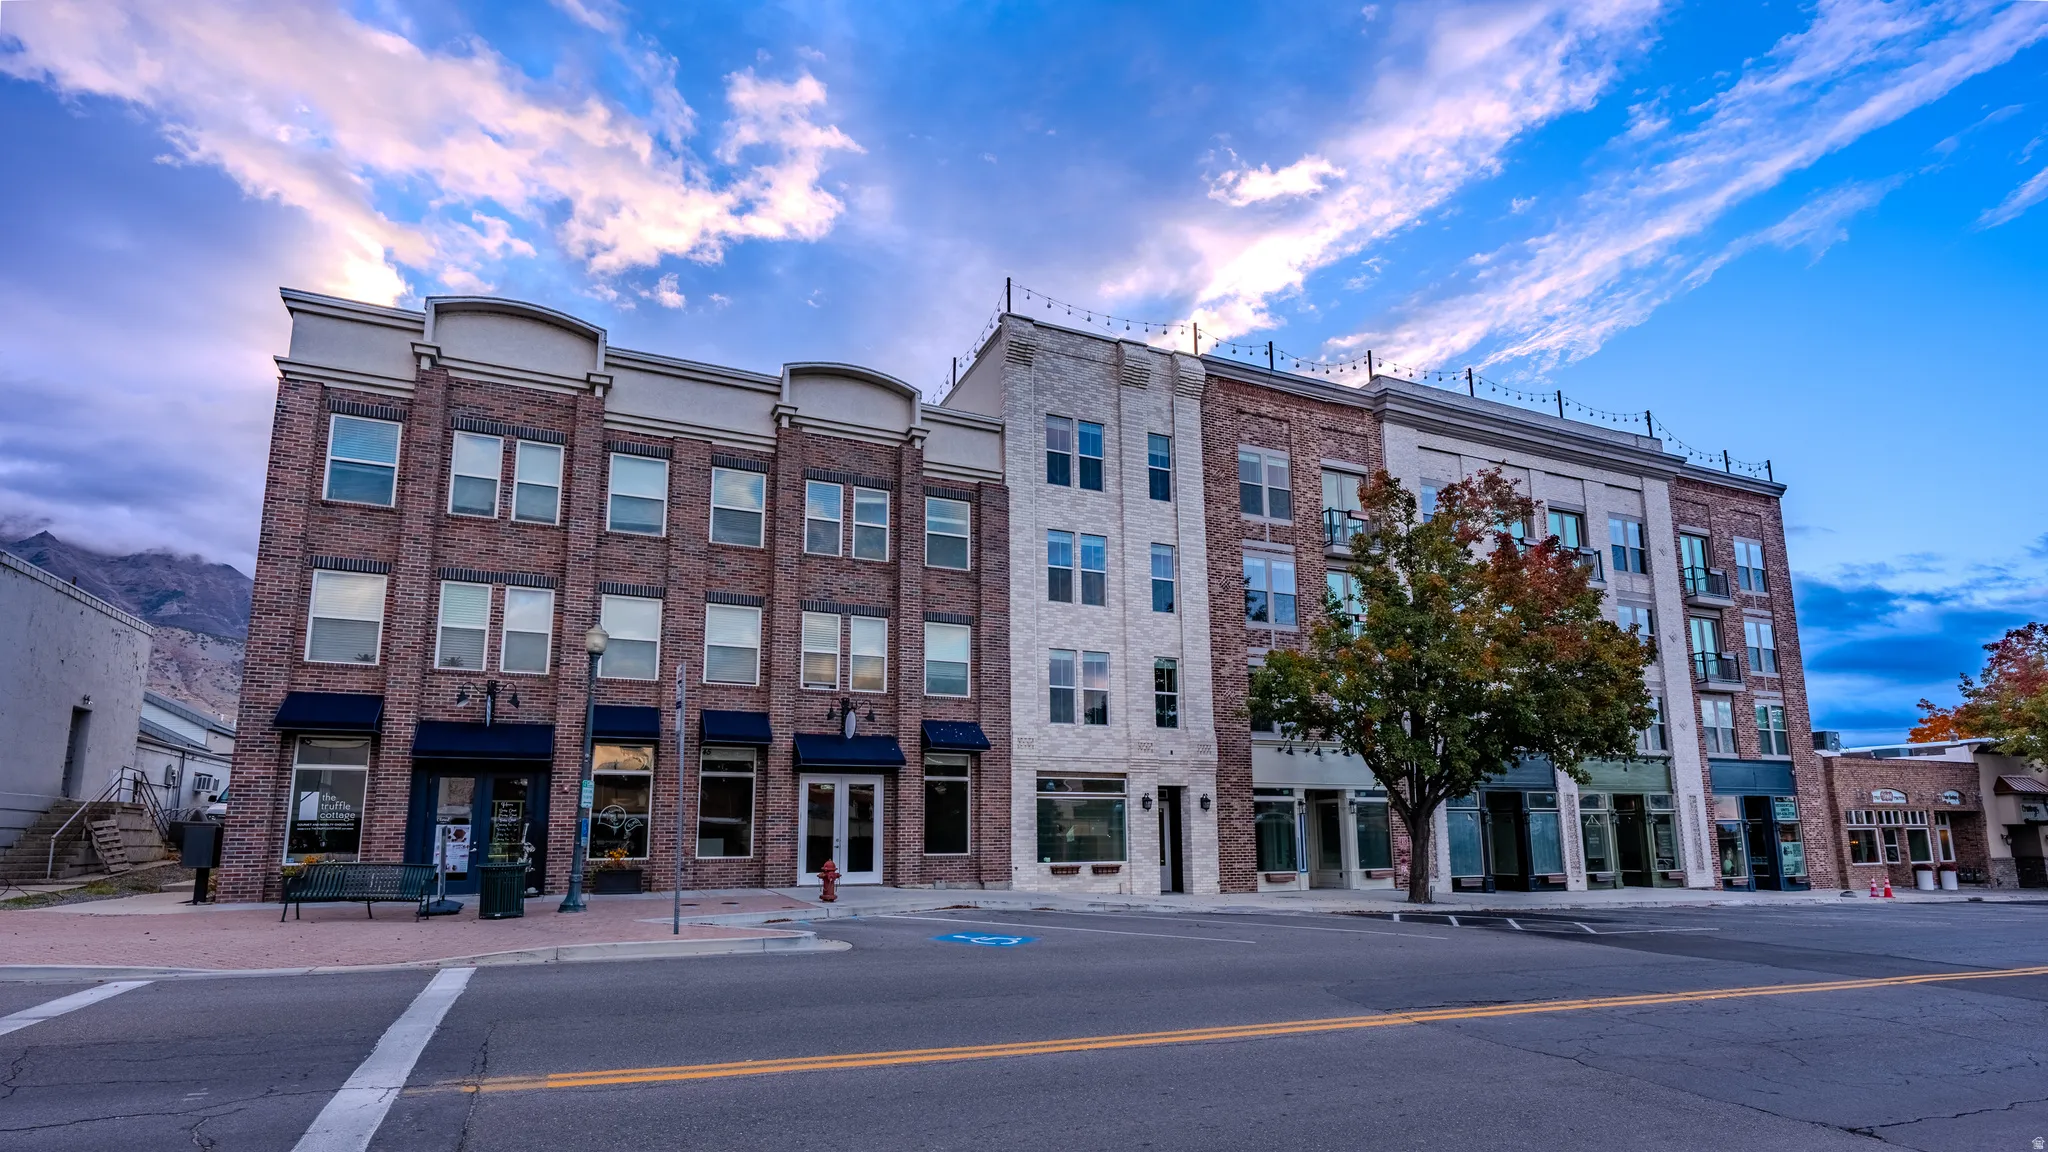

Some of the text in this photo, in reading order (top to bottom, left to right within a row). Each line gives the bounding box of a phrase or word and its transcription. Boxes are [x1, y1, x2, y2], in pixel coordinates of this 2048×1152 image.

[322, 792, 337, 801] the
[321, 801, 351, 810] truffle
[319, 812, 356, 822] cottage
